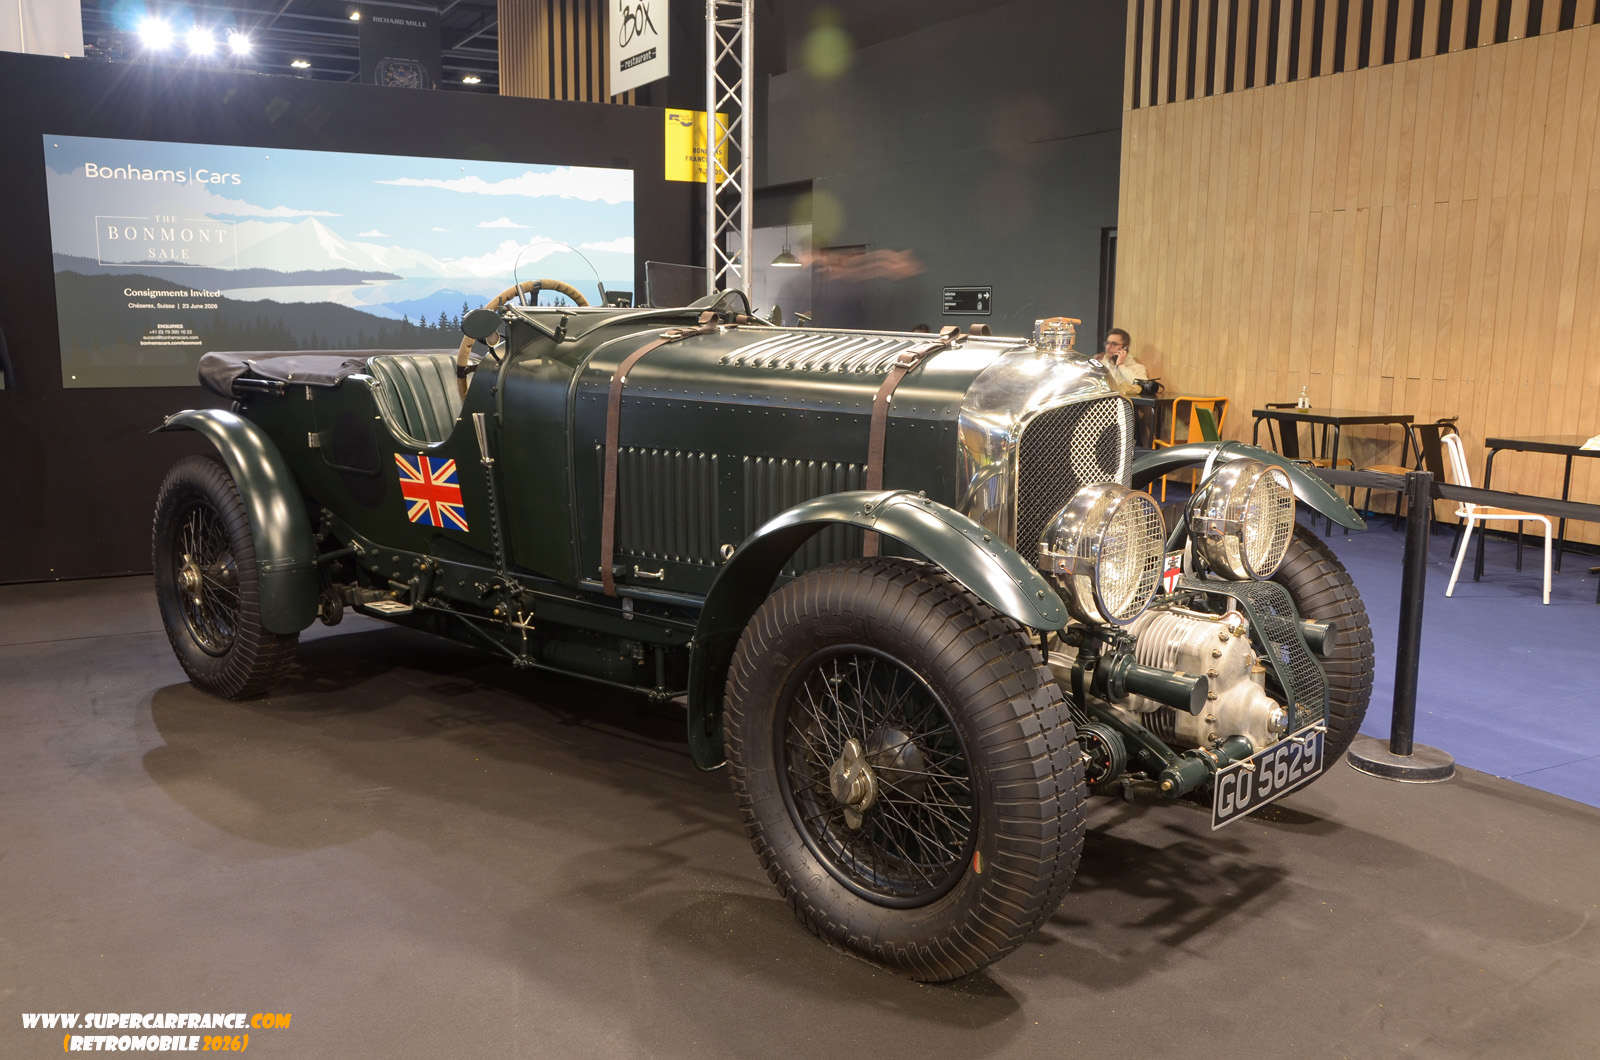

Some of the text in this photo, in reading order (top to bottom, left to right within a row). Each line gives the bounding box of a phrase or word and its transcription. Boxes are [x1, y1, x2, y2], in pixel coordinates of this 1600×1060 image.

[373, 16, 427, 28] RICHARD MILLE
[619, 2, 658, 48] BOX
[624, 50, 652, 69] restaurant
[85, 162, 242, 185] Bonhams Cars
[154, 215, 178, 223] THE
[107, 225, 227, 243] BONMONT
[148, 248, 190, 259] SALE
[123, 288, 221, 298] Consignments Invited
[1217, 731, 1317, 818] GO 5629
